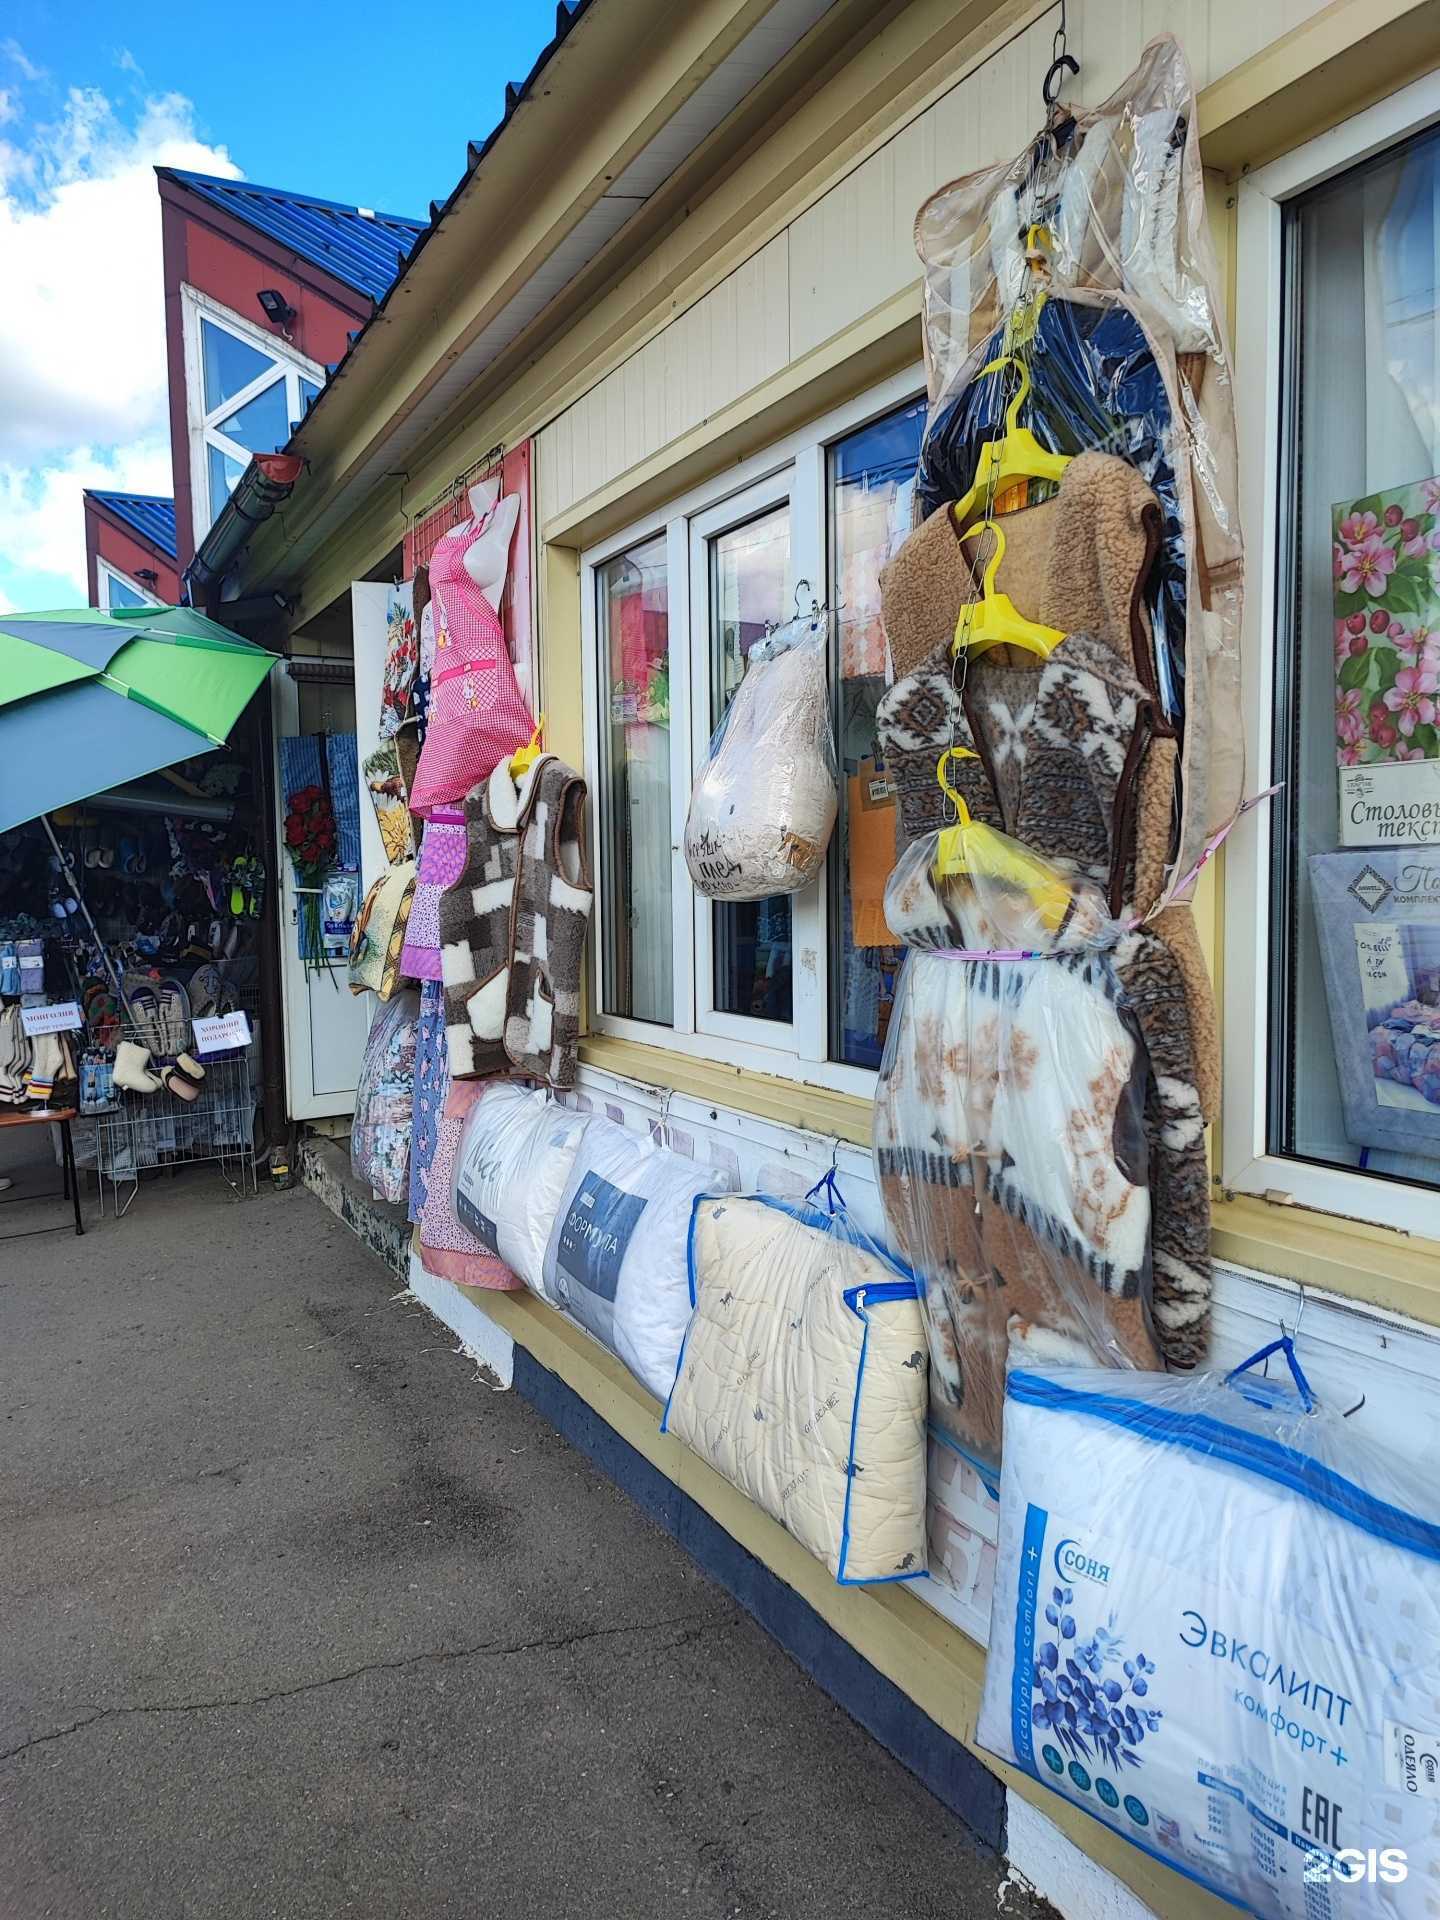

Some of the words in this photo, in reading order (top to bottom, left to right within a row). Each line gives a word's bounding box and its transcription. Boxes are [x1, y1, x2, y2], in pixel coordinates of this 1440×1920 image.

[1064, 1549, 1111, 1583] СОНЯ
[1022, 1567, 1036, 1648] comfort
[1018, 1656, 1032, 1761] Eucalyptus
[1403, 1733, 1418, 1793] ОДЕЯЛО
